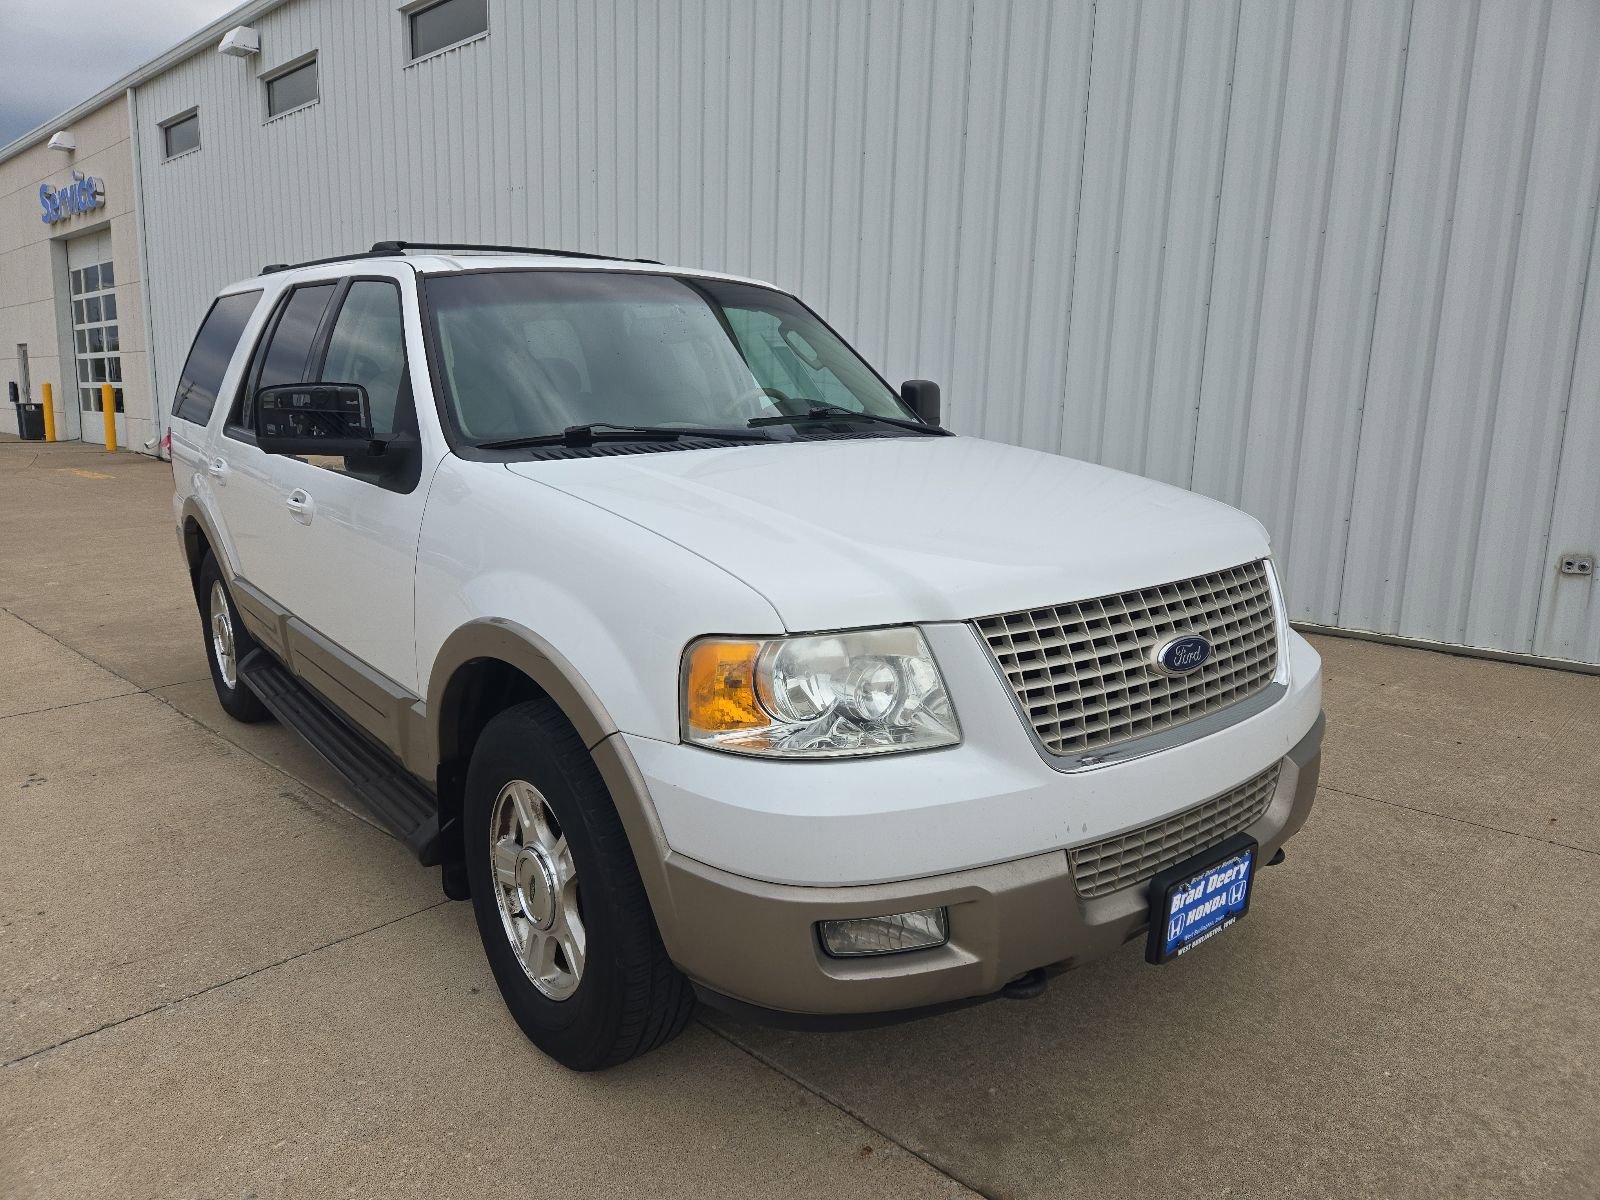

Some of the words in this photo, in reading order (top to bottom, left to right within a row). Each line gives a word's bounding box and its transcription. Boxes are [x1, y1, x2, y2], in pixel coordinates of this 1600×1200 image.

[40, 172, 99, 224] Service
[1173, 642, 1202, 667] Ford
[1170, 880, 1206, 914] Brad
[1185, 892, 1227, 926] HONDA
